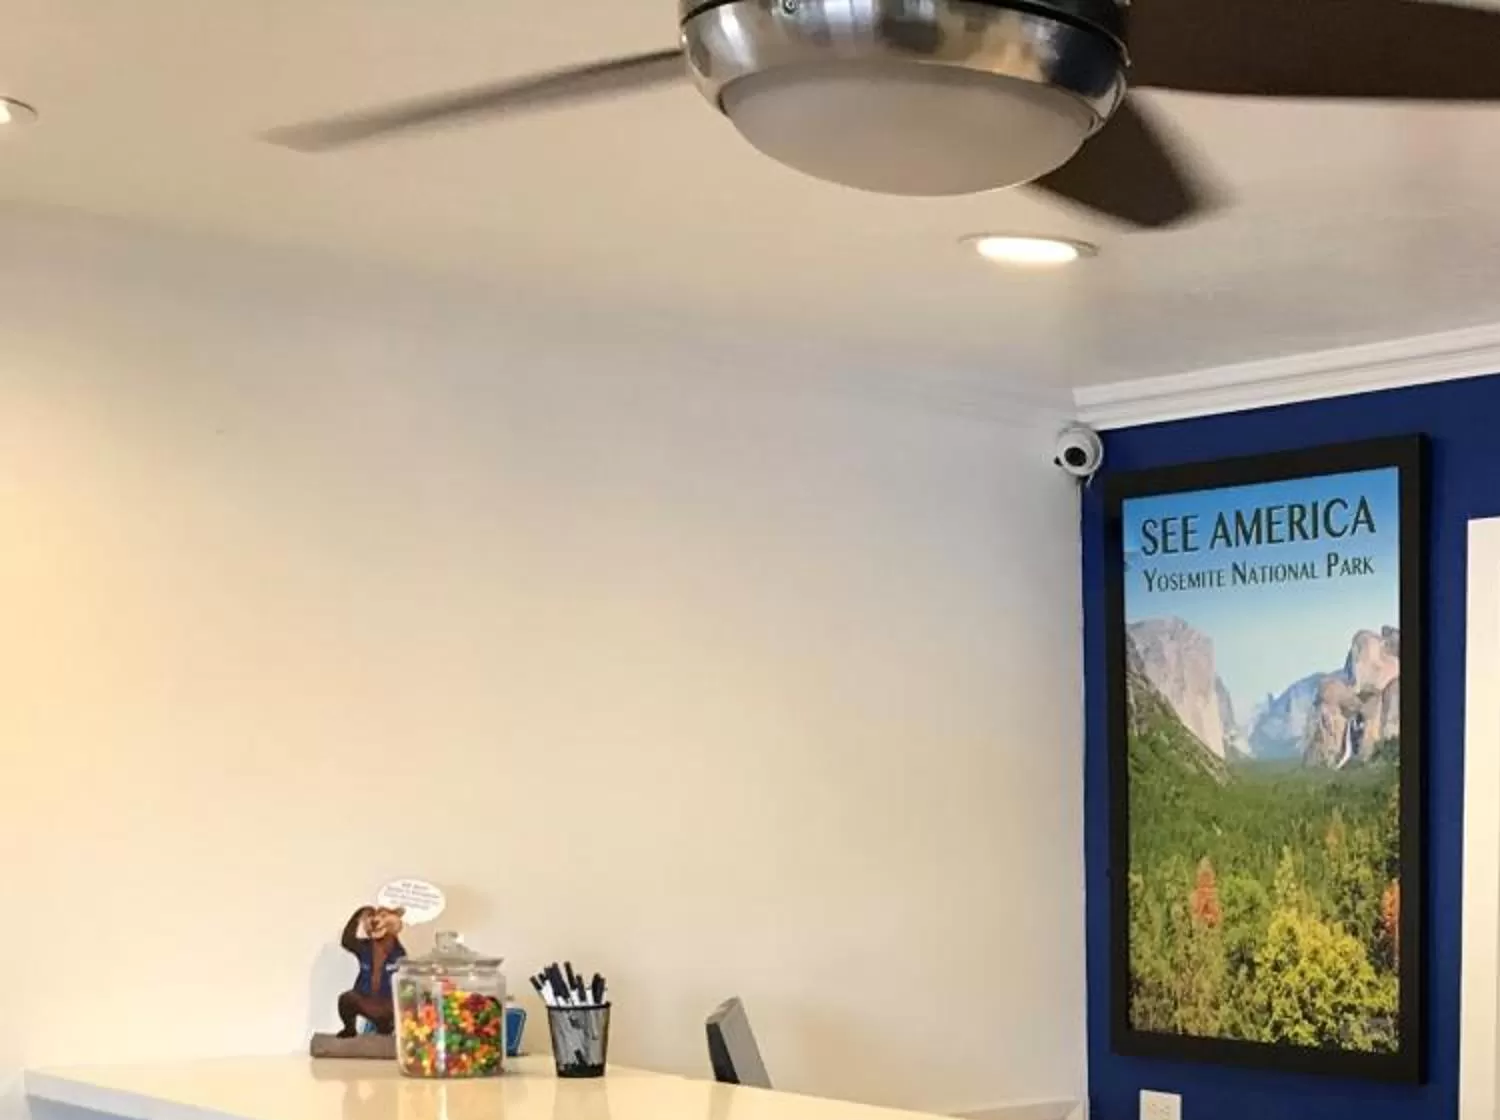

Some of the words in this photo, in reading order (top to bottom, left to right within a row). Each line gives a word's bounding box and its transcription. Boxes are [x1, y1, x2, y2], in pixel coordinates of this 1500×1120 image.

[1141, 515, 1199, 556] SEE
[1209, 496, 1376, 549] AMERICA
[1143, 570, 1225, 592] YOSEMITE
[1231, 560, 1319, 586] NATIONAL
[1326, 552, 1375, 578] PARK
